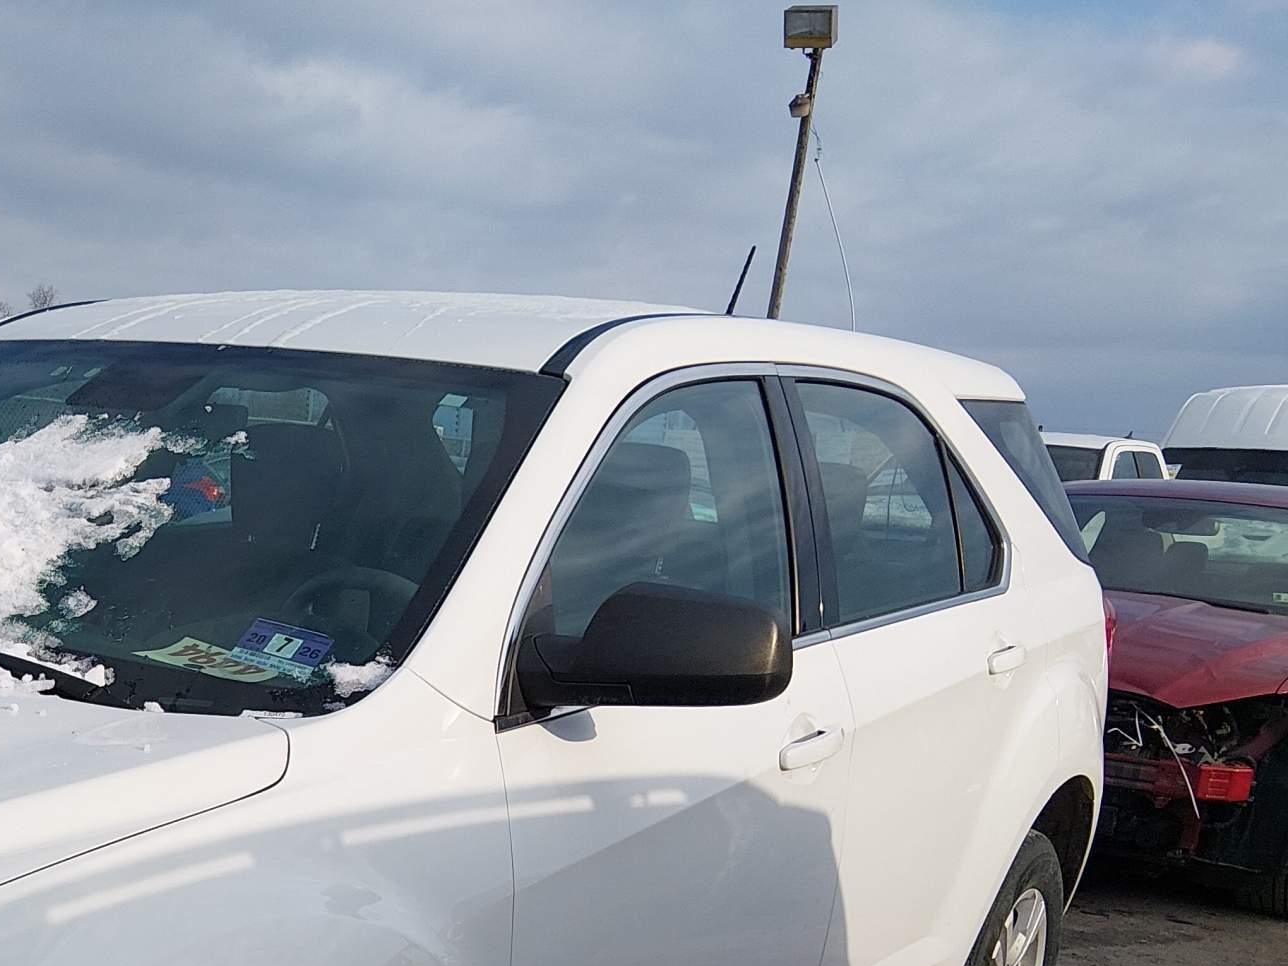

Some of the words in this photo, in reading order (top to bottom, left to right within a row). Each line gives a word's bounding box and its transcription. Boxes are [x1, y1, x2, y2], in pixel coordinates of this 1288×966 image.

[246, 633, 266, 645] 20
[276, 637, 294, 652] 7
[299, 646, 321, 659] 26
